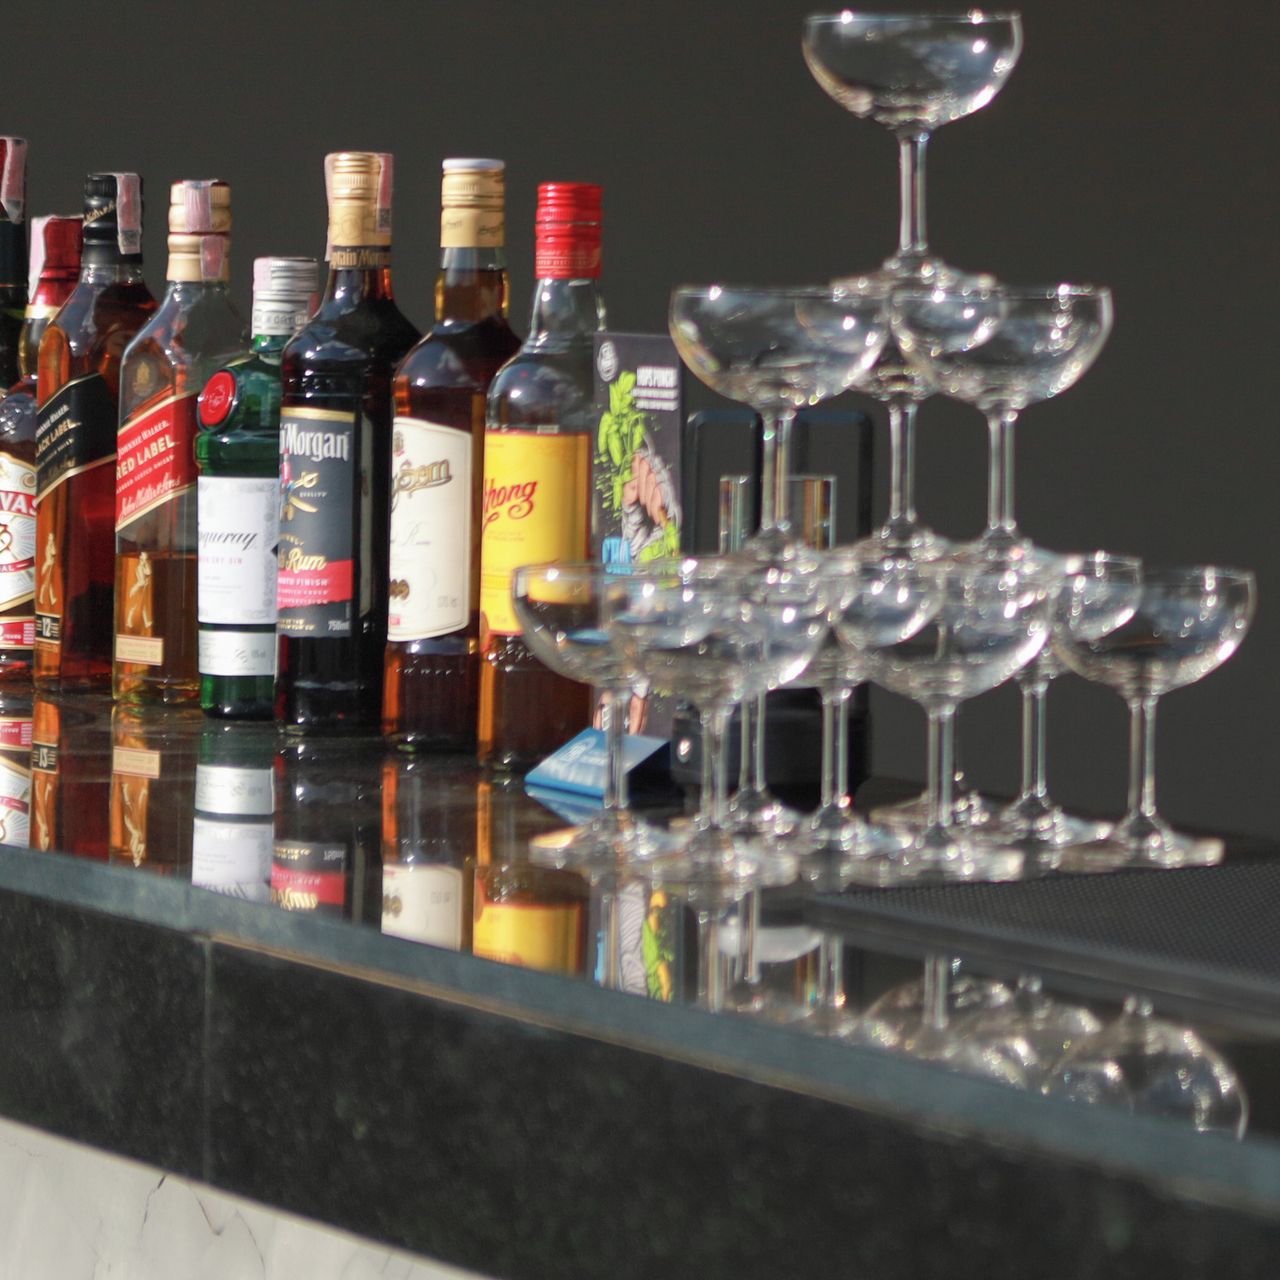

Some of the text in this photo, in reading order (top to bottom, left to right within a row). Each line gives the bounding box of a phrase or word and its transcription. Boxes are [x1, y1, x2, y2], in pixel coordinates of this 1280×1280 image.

[50, 418, 78, 442] LABEL
[284, 423, 350, 462] Morgan
[136, 433, 177, 465] LABEL
[288, 547, 328, 573] Rum
[42, 616, 53, 638] 12
